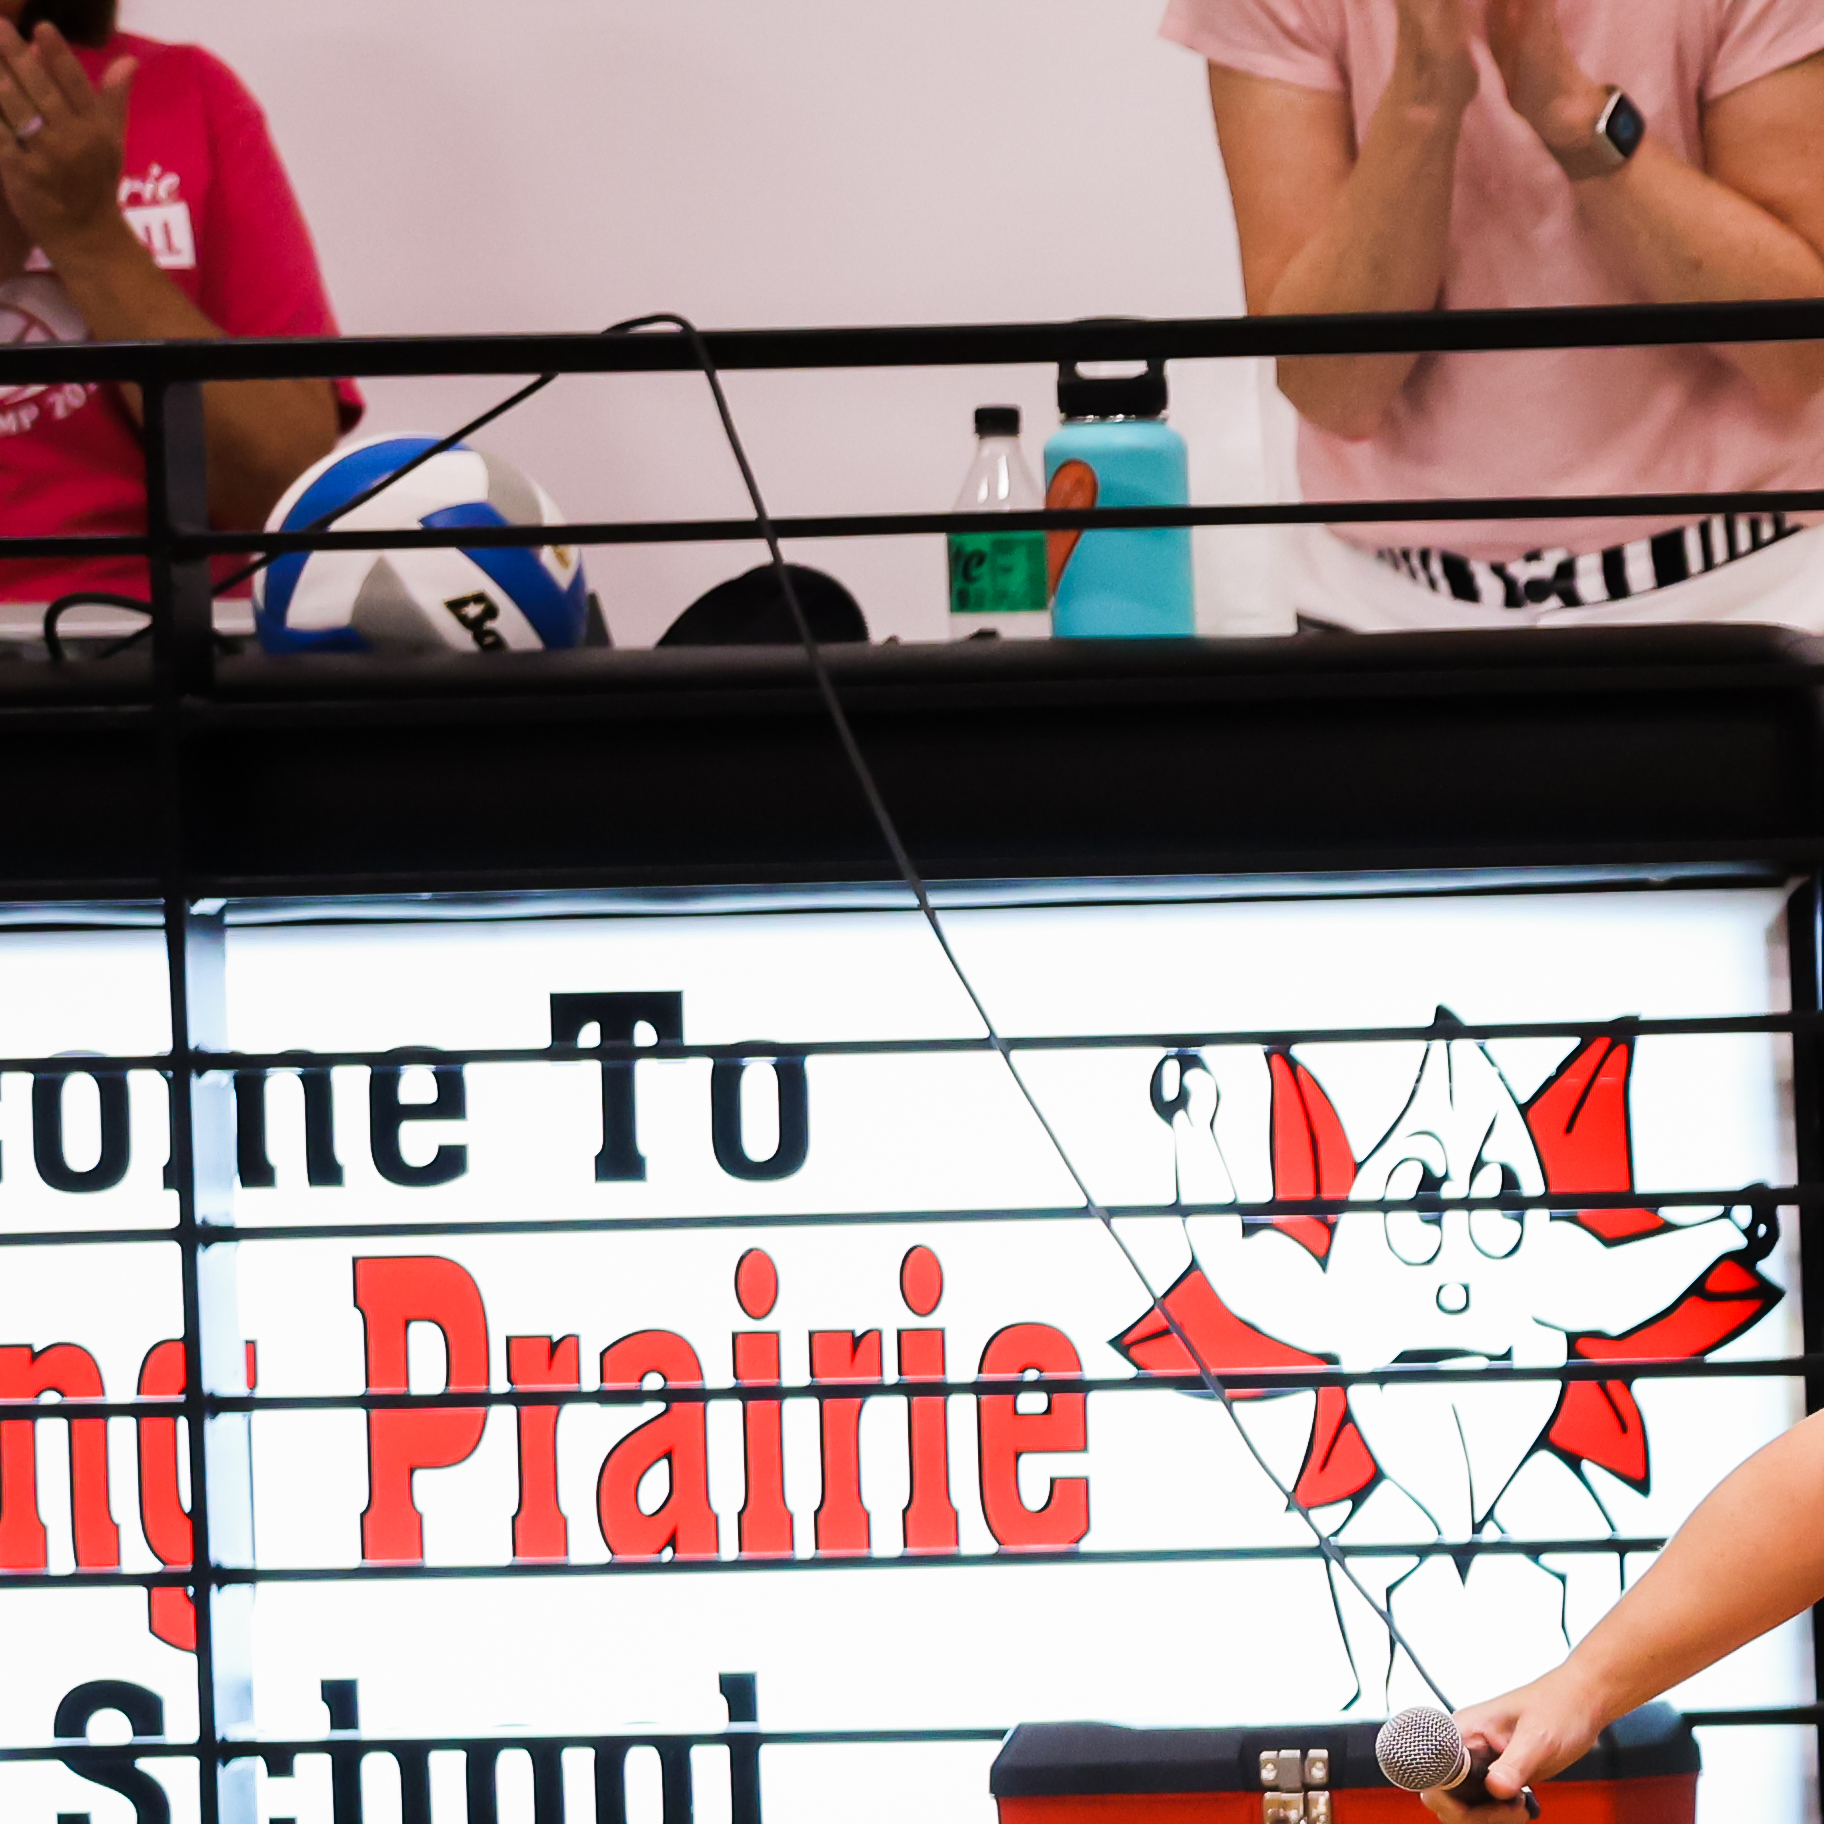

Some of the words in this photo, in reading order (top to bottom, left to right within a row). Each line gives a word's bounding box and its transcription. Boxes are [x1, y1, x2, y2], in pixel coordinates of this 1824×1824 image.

[0, 1046, 468, 1193] ome
[549, 991, 809, 1182] To
[352, 1245, 1090, 1566] Prairie
